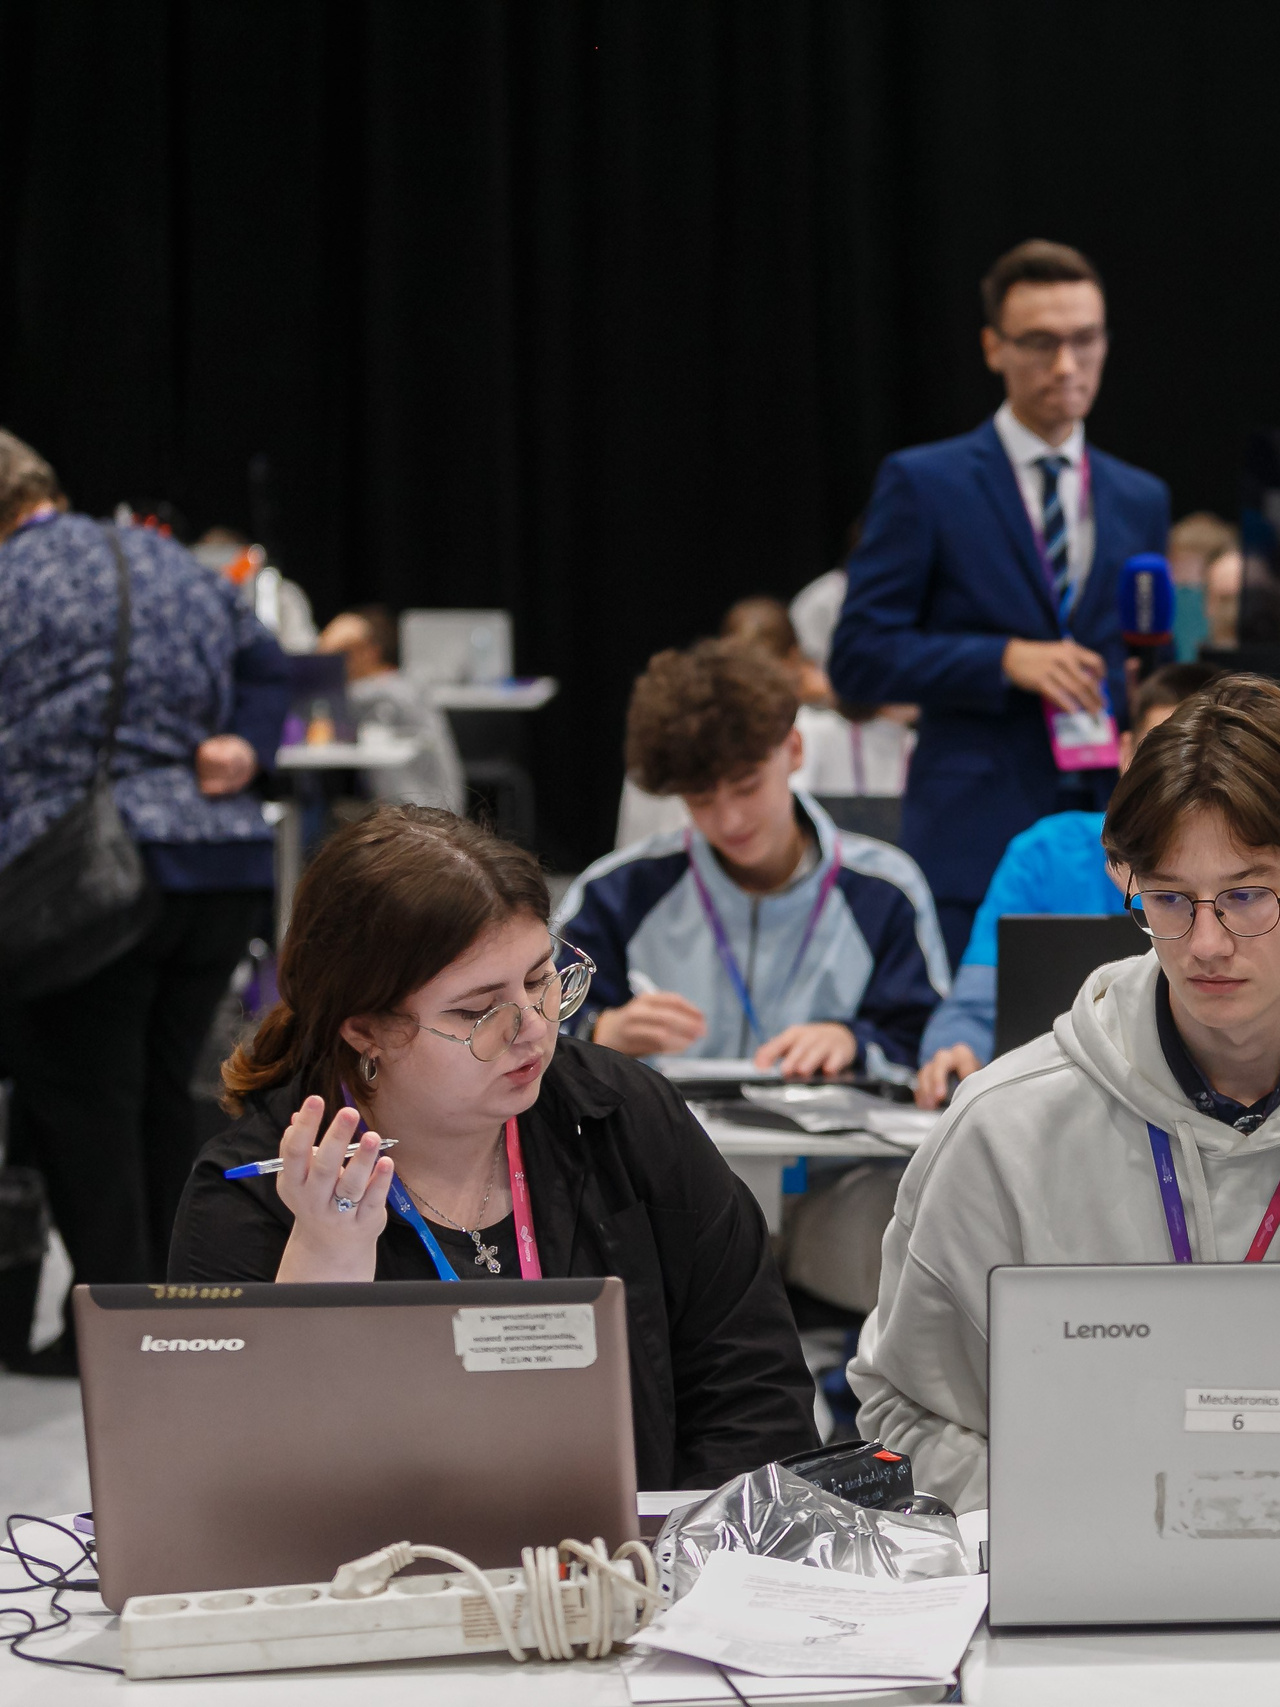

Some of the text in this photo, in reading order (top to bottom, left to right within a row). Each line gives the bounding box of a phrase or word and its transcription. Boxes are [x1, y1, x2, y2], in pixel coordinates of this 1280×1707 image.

[1063, 1321, 1150, 1339] Lenovo
[141, 1335, 245, 1352] lenovo
[1198, 1393, 1280, 1407] Mechatronics
[1232, 1414, 1244, 1431] 6
